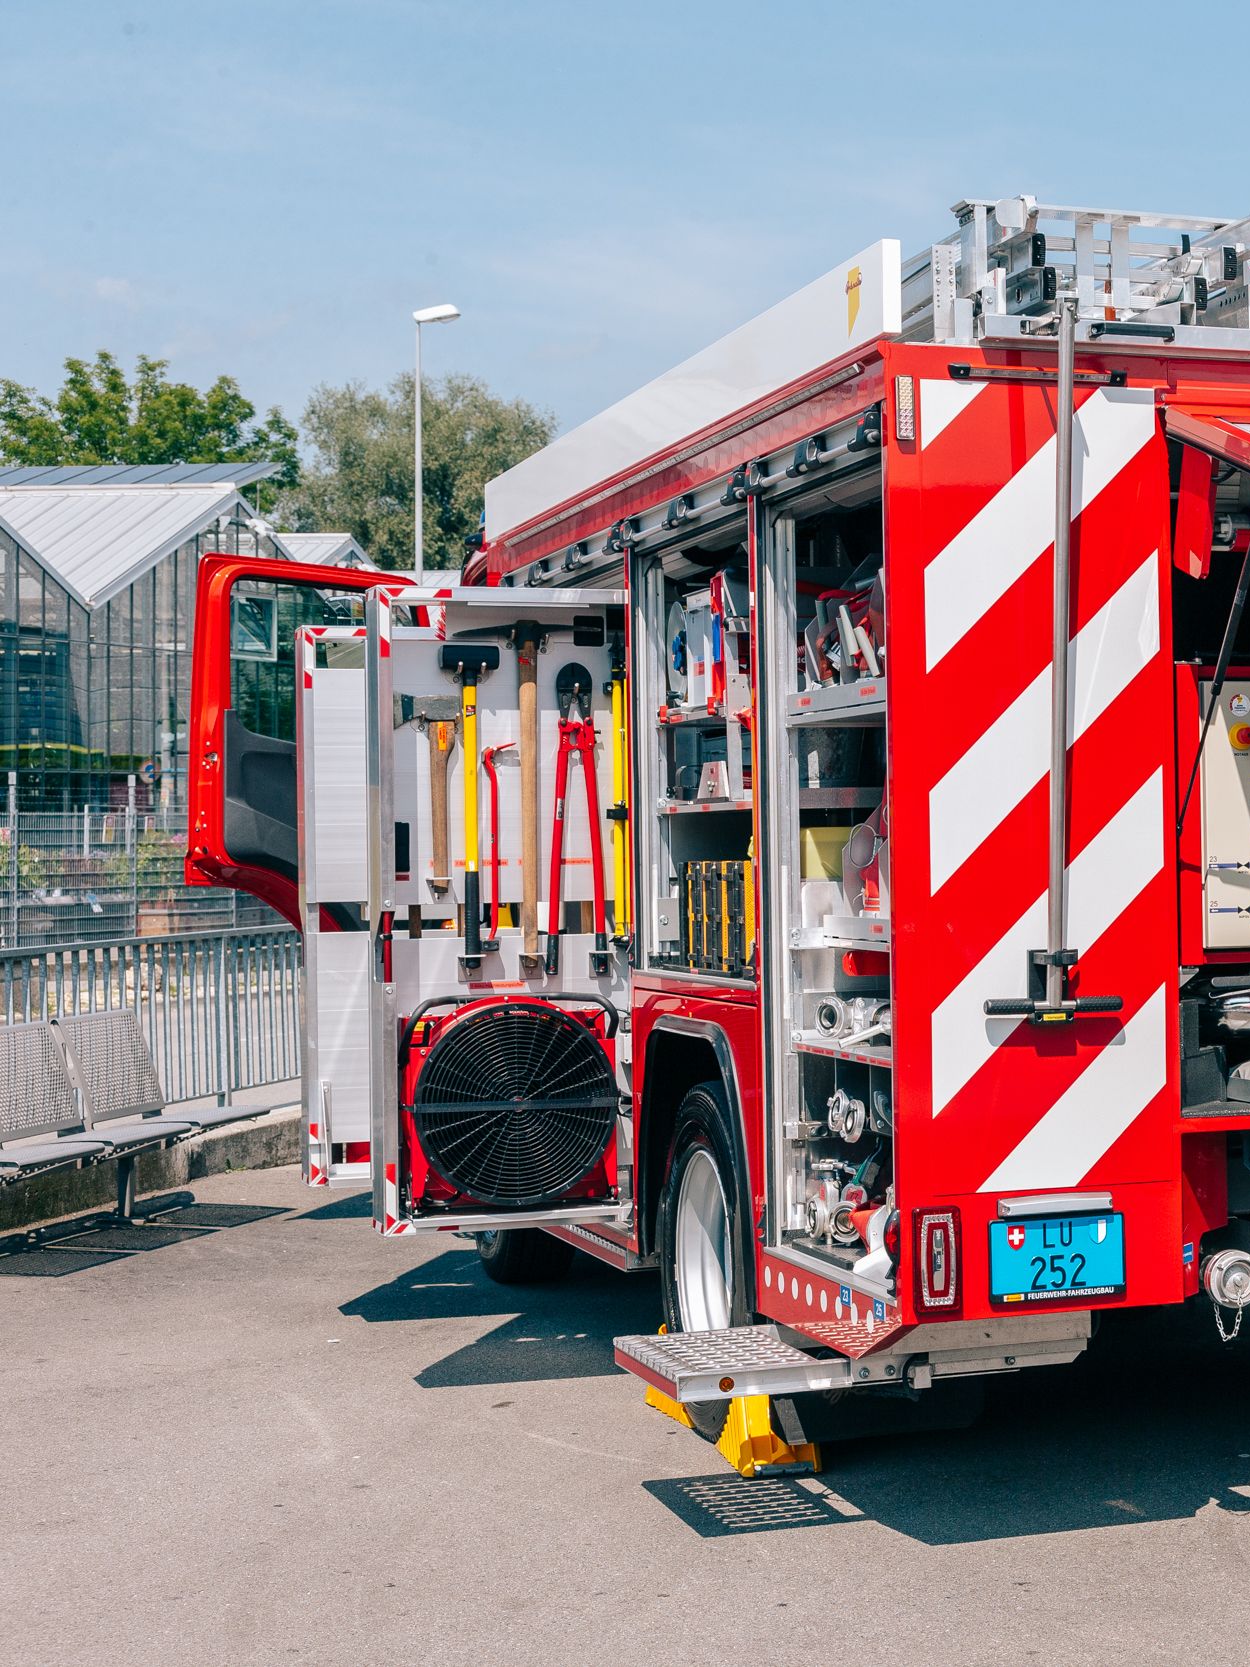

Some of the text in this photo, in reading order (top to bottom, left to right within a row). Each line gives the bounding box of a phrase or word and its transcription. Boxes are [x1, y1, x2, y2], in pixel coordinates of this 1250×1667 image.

[1209, 855, 1218, 863] 23
[1209, 900, 1218, 908] 25
[1042, 1220, 1073, 1249] LU
[1030, 1253, 1087, 1291] 252
[842, 1289, 849, 1303] 23
[1027, 1286, 1115, 1301] FEUERWEHR-FAHRZEUGBAU
[875, 1303, 883, 1317] 25
